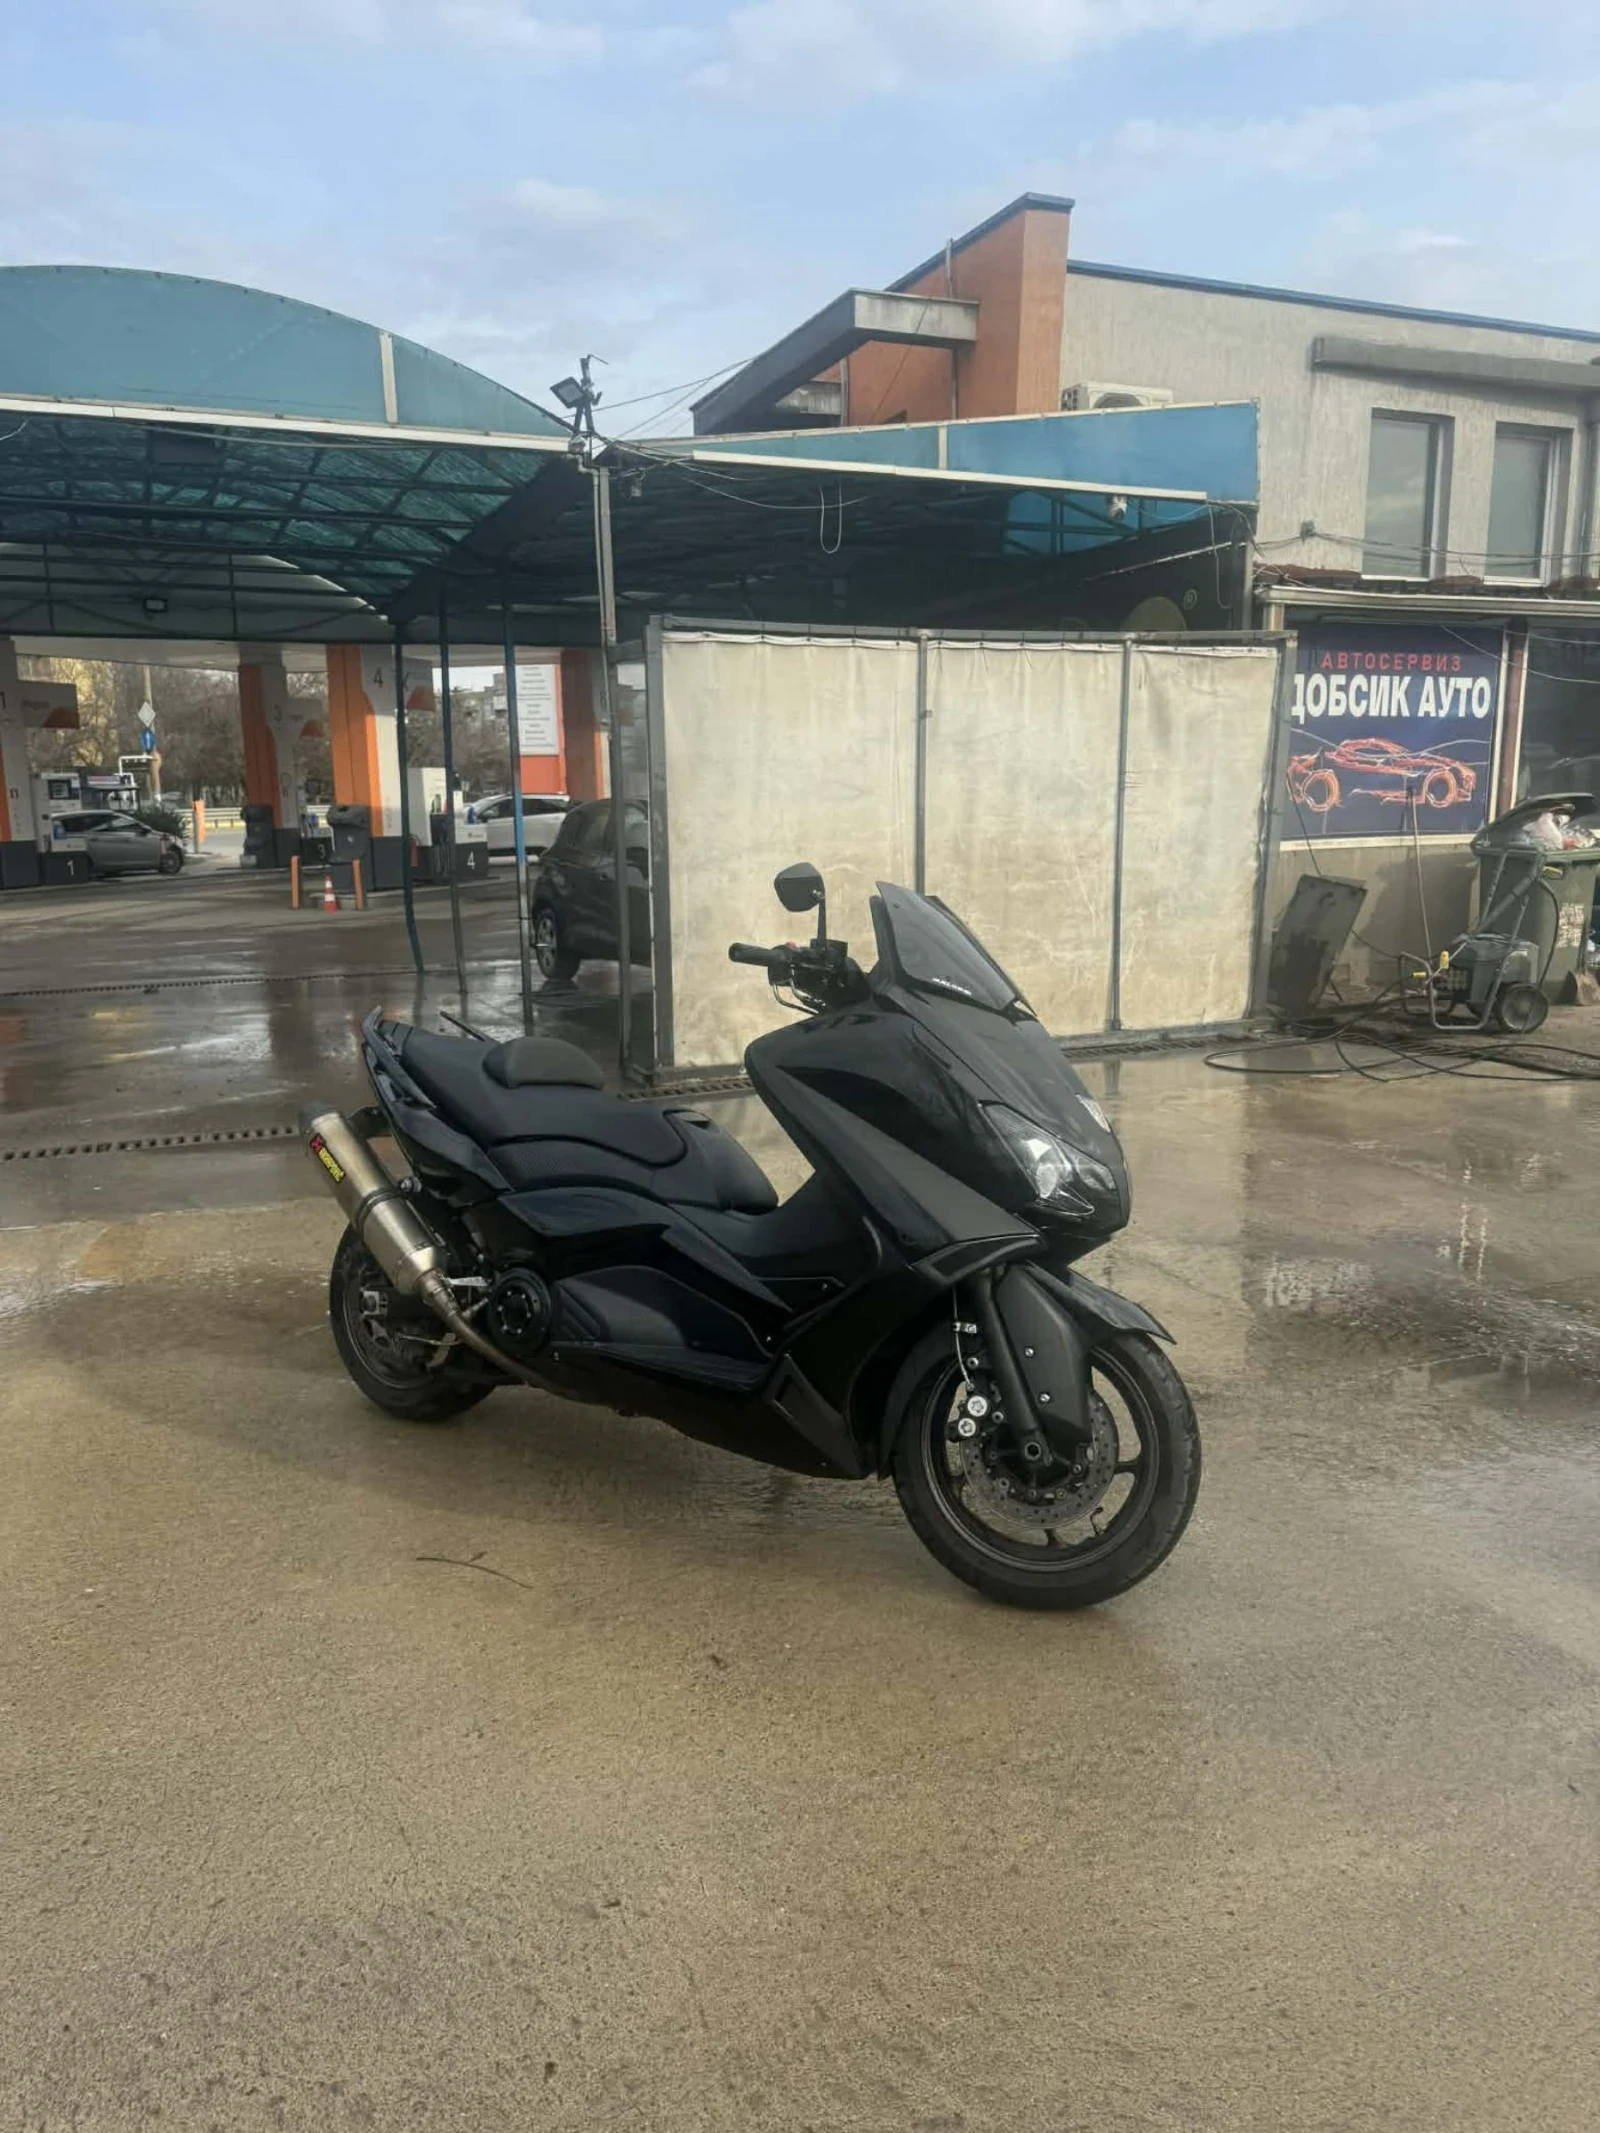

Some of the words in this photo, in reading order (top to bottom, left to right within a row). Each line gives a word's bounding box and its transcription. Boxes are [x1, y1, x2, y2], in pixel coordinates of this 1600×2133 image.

[1321, 652, 1461, 672] АВТОСЕРВИЗ
[374, 667, 384, 689] 4
[1417, 675, 1491, 719] АУТО
[67, 859, 75, 877] 1
[467, 851, 476, 870] 4
